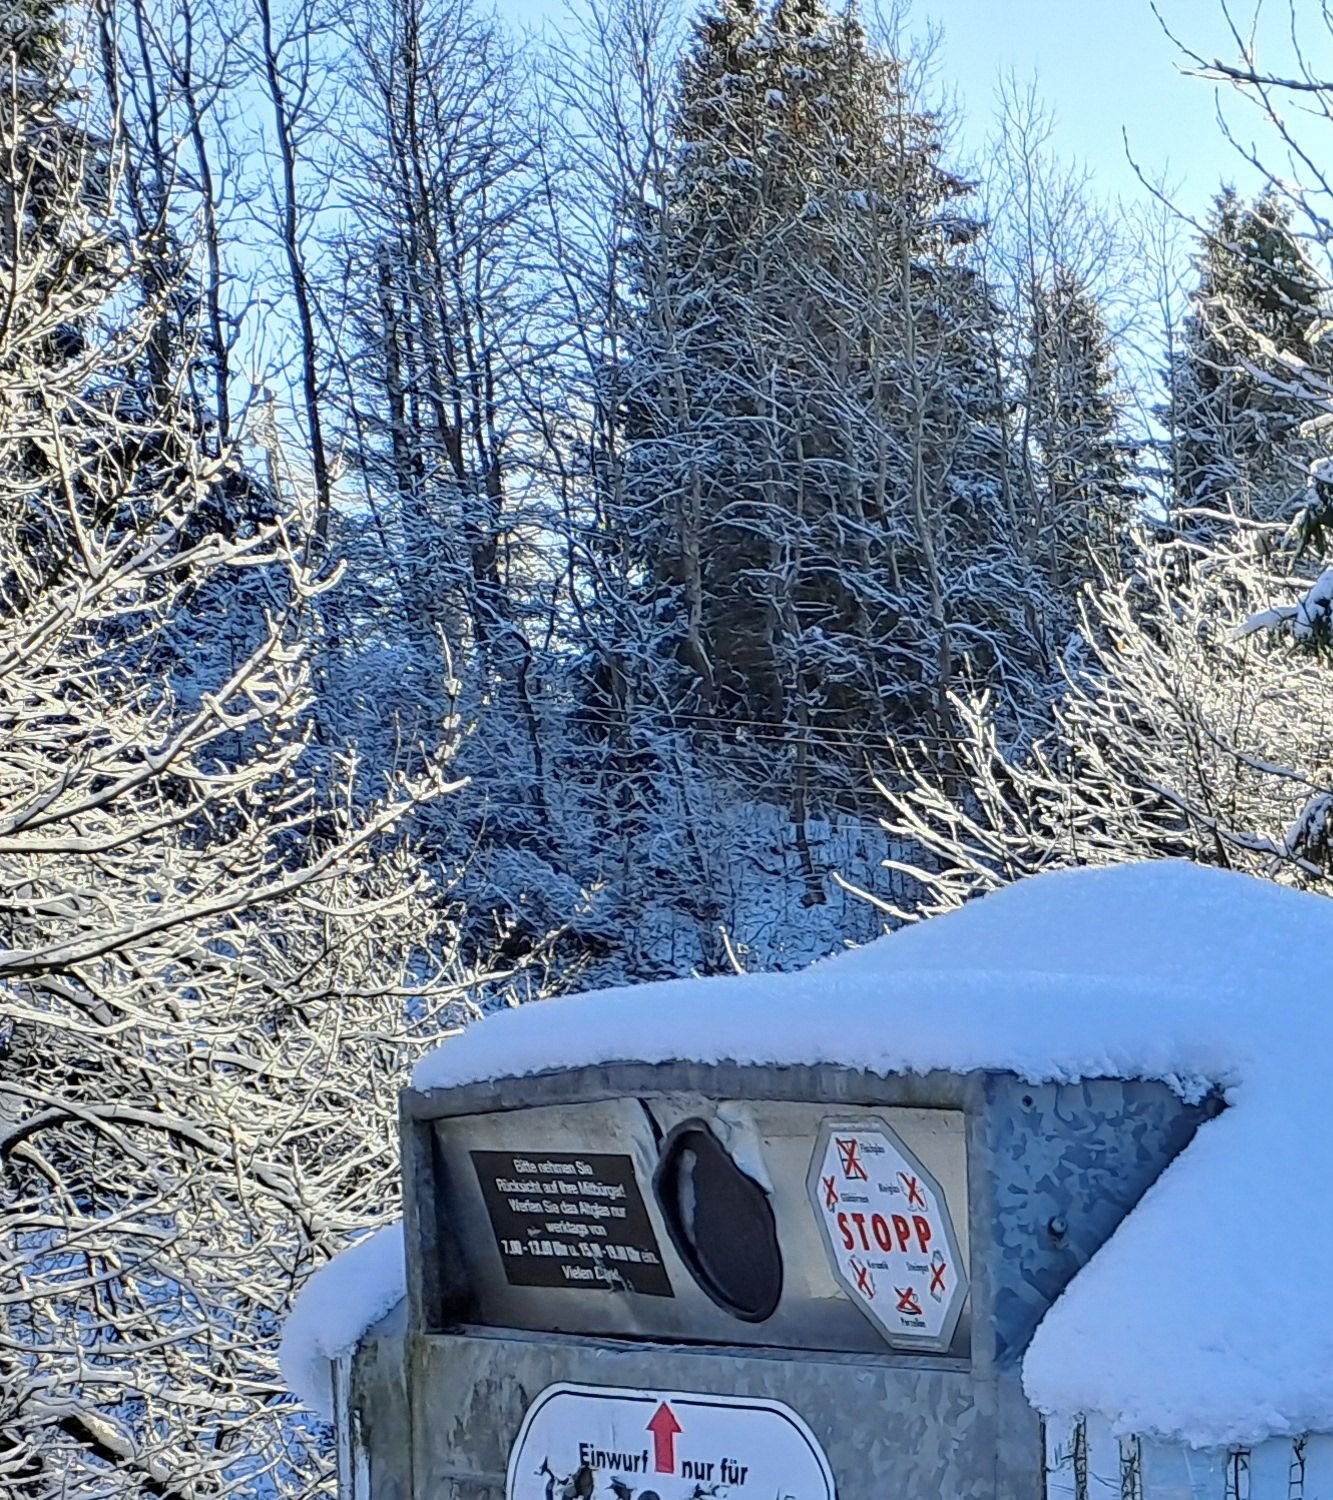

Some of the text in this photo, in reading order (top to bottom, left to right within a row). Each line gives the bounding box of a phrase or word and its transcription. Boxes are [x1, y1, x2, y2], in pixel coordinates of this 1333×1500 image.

[513, 1159, 593, 1175] Bitte nehmen Sie
[495, 1178, 543, 1194] Rücksicht
[542, 1181, 559, 1194] auf
[558, 1181, 579, 1195] Ihre
[508, 1198, 627, 1219] Werfen Sie das Altglas nur
[544, 1220, 608, 1238] werktags von
[837, 1212, 931, 1254] STOPP
[561, 1265, 595, 1280] Vielen
[578, 1443, 749, 1486] Einwurf nur für
